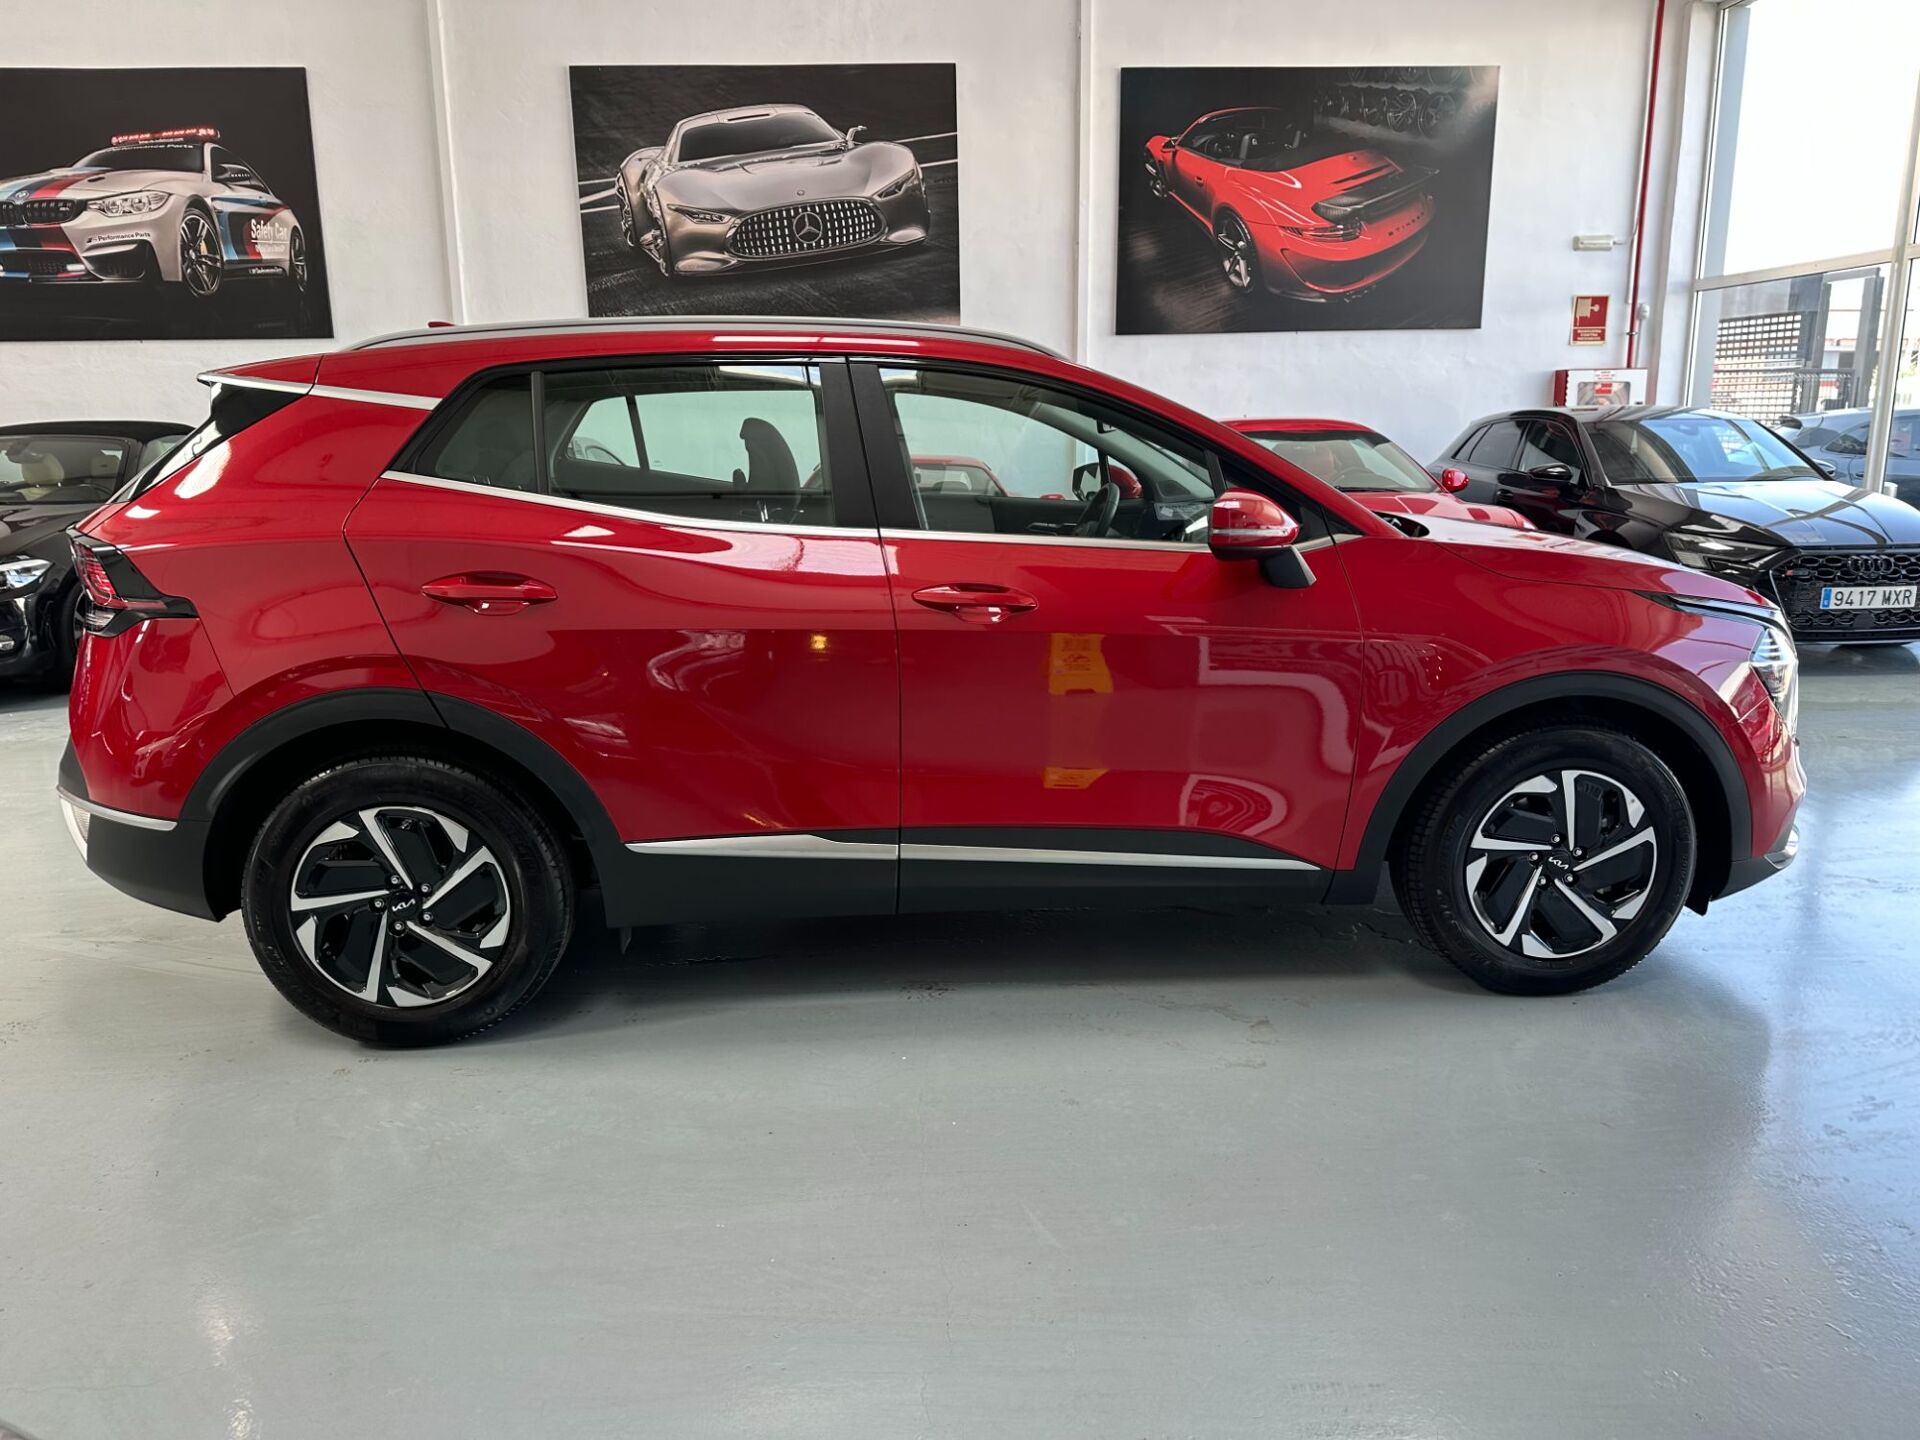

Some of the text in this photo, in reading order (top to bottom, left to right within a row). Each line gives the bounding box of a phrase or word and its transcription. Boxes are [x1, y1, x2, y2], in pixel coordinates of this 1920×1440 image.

[98, 233, 134, 241] Performance
[251, 219, 288, 244] Safety Car
[1834, 590, 1877, 607] 9417
[1881, 589, 1912, 606] MXR
